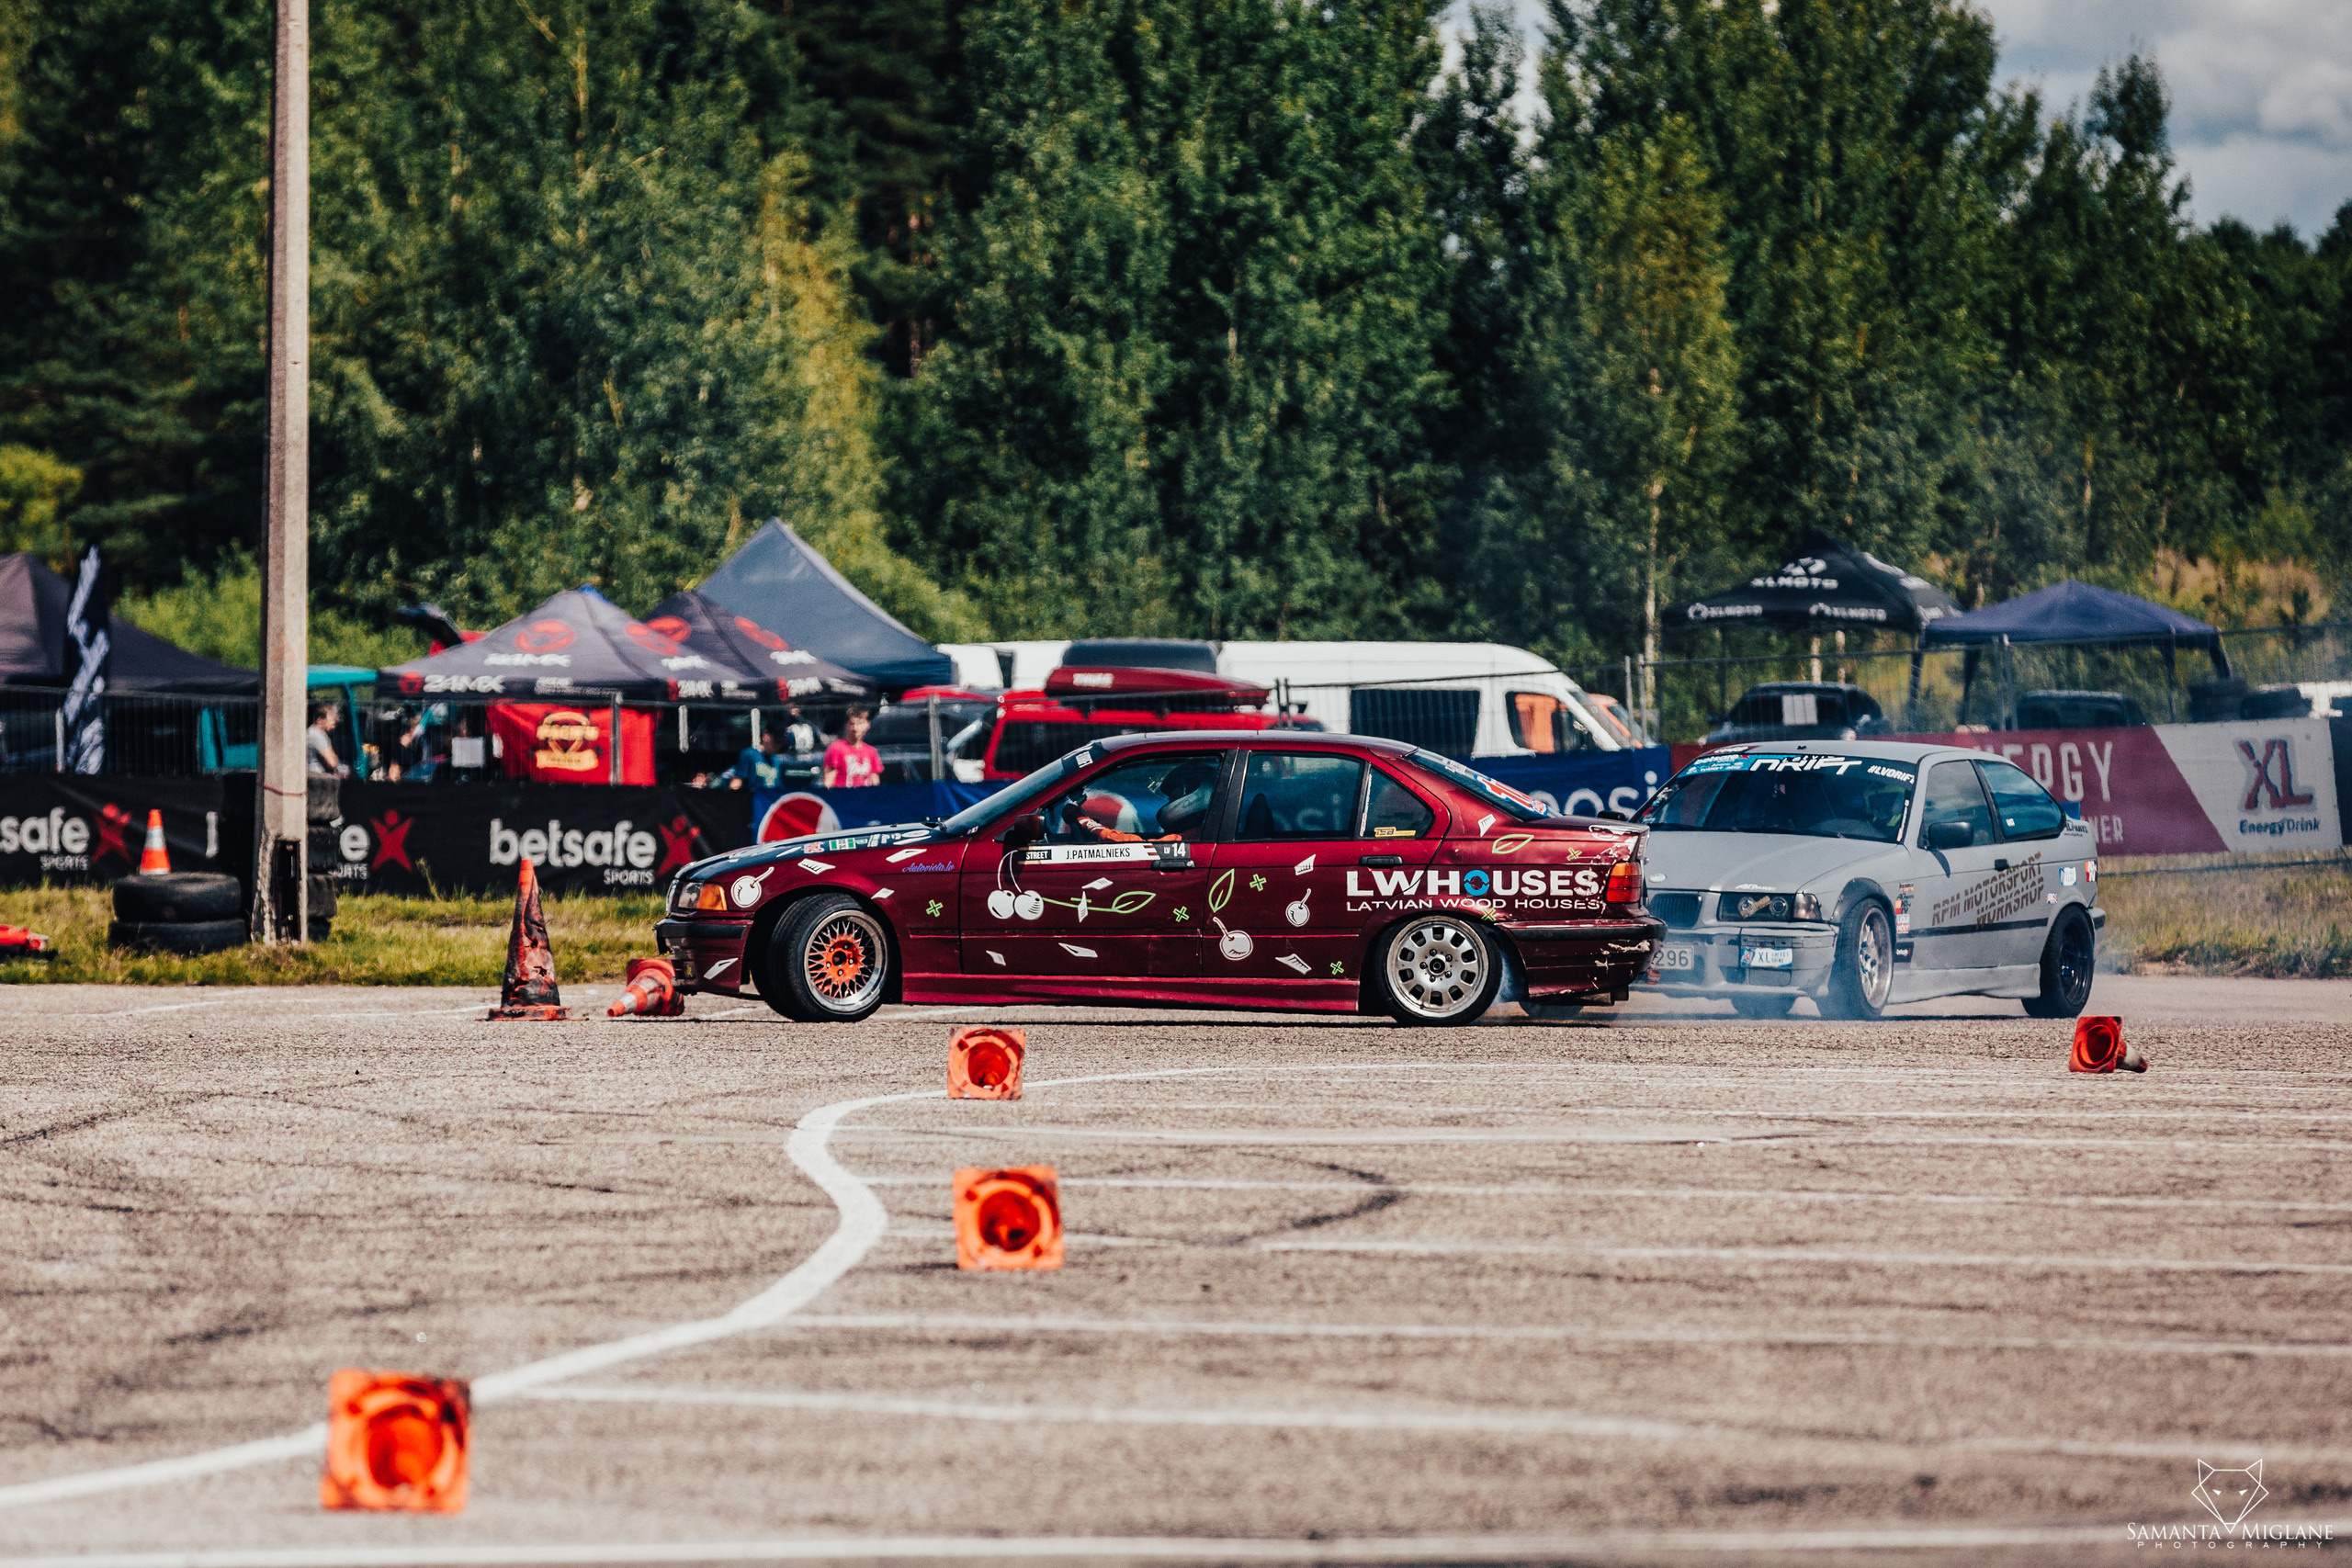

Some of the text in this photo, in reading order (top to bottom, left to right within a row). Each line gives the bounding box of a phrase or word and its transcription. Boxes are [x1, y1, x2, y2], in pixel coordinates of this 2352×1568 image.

[2235, 737, 2315, 812] XL
[489, 818, 657, 868] betsafe
[1163, 842, 1186, 857] LV 14
[1025, 851, 1048, 860] STREET
[1066, 847, 1131, 860] J.PATMALNIEKS
[603, 868, 655, 886] SPORTS
[1346, 869, 1600, 897] LWHOUSES
[1346, 897, 1602, 912] LATVIAN WOOD HOUSES
[1758, 951, 1770, 963] XL
